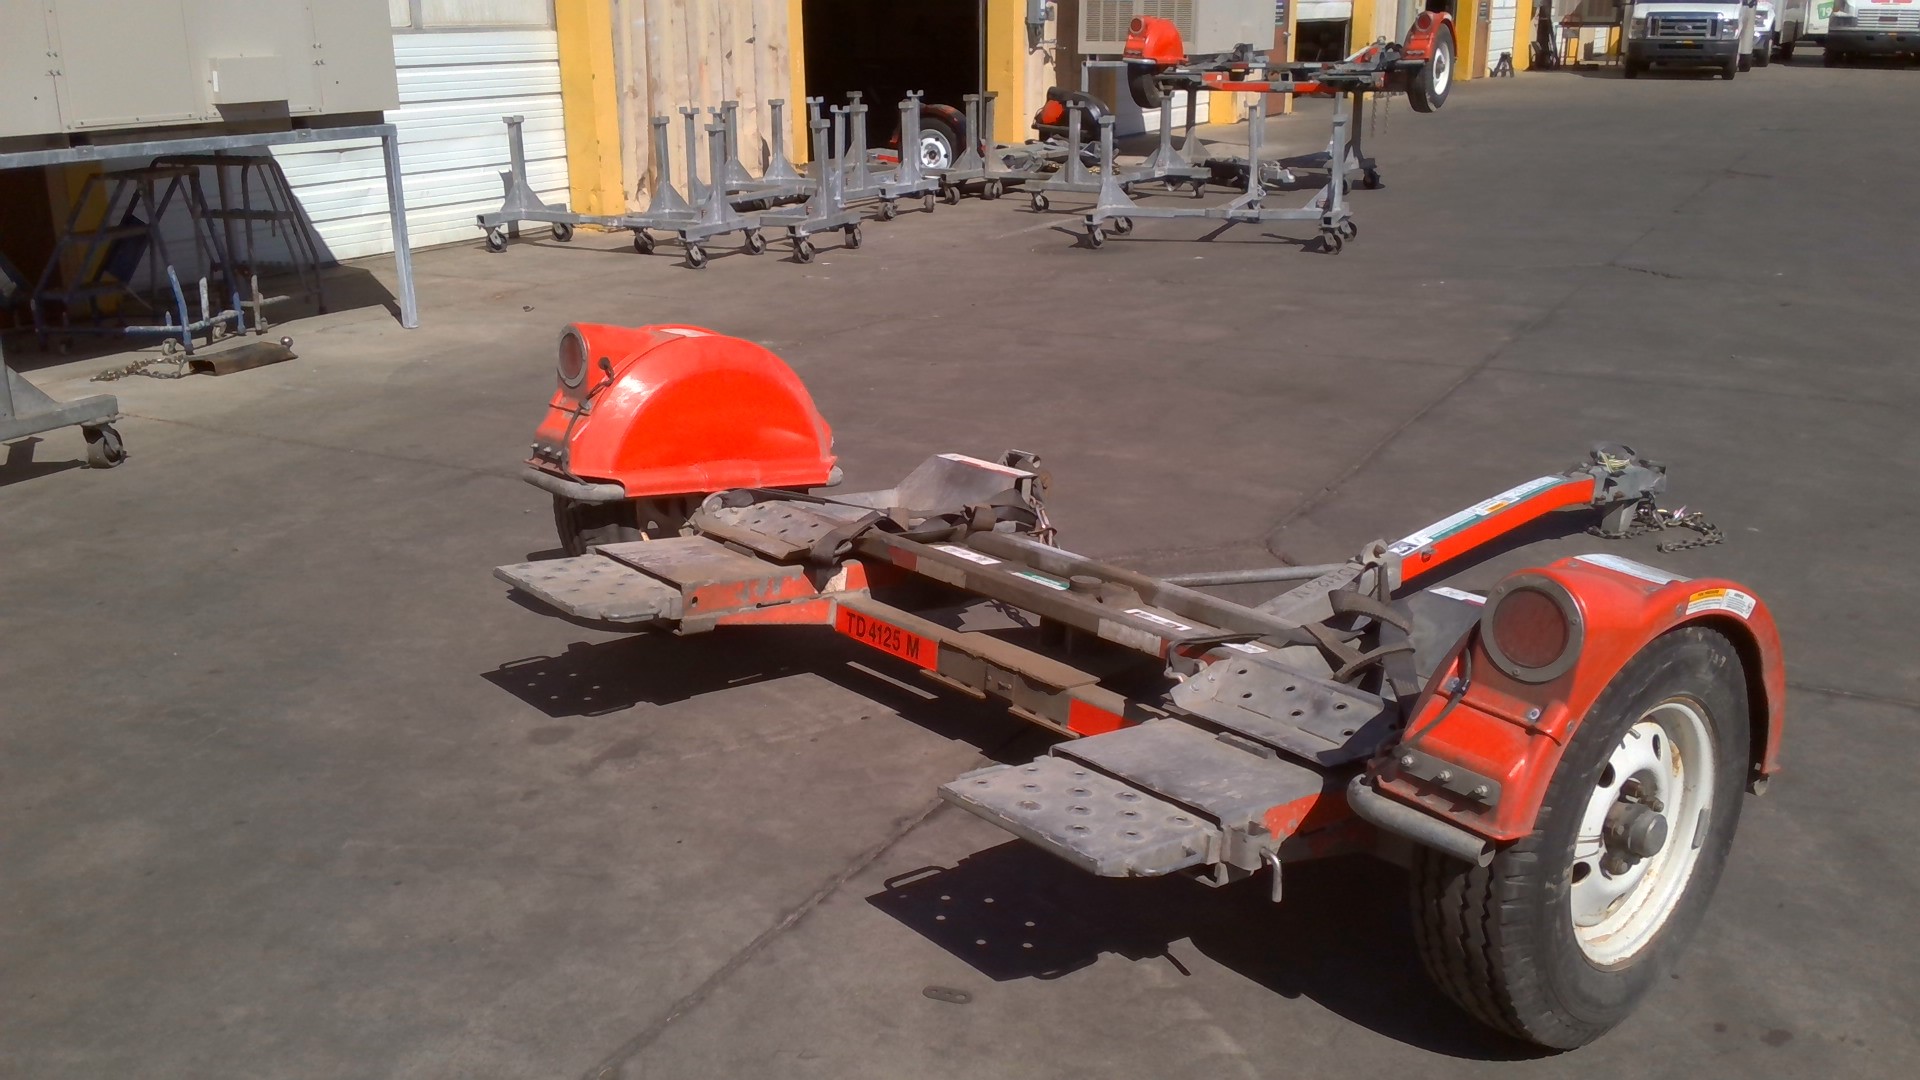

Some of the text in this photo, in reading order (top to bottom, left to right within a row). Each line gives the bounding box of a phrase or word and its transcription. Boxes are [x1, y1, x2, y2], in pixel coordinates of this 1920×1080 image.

[846, 611, 920, 659] TD 4125 M
